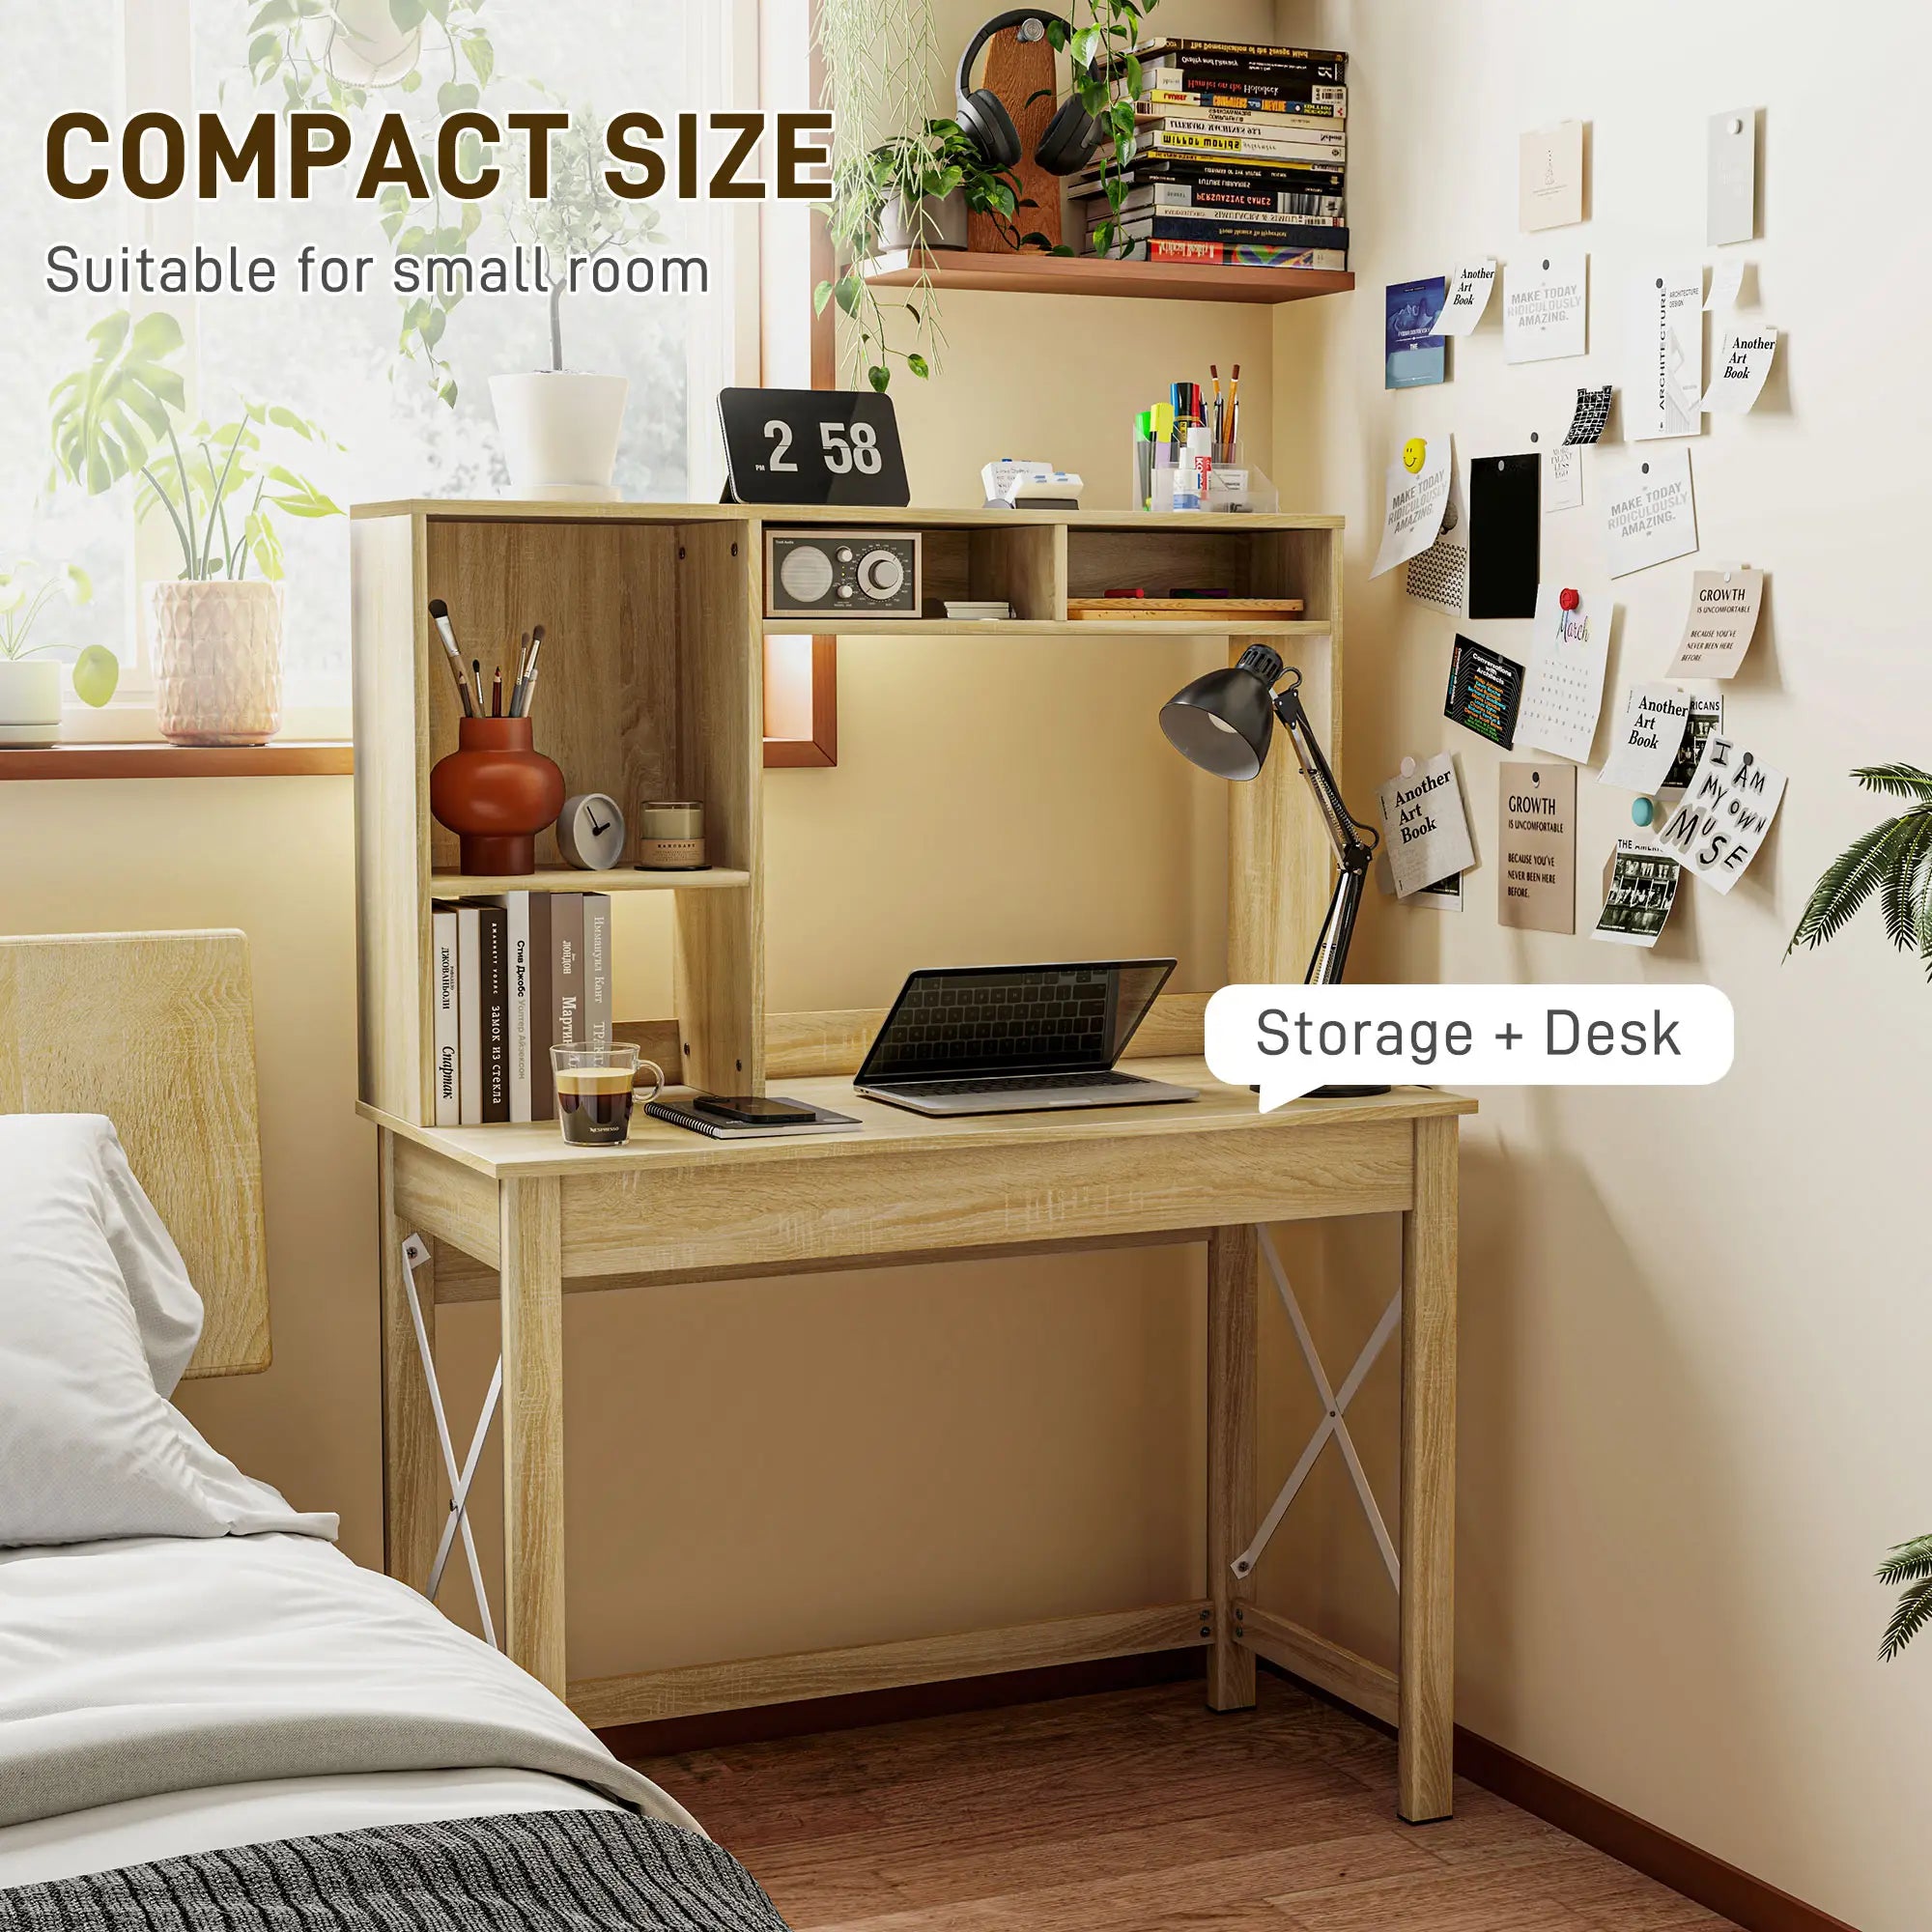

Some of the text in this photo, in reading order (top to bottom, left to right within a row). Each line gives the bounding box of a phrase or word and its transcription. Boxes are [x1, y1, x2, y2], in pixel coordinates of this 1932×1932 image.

[1461, 268, 1494, 279] Another
[1458, 282, 1472, 292] Art
[1511, 284, 1577, 304] MAKE TODAY
[1453, 294, 1474, 305] Book
[1507, 296, 1581, 317] RIDICULOUSLY
[1519, 310, 1569, 327] AMAZING.
[1733, 337, 1776, 349] Another
[1729, 352, 1747, 364] Art
[1724, 366, 1750, 379] Book
[764, 420, 798, 472] 2
[820, 422, 882, 474] 58
[1392, 469, 1445, 510] MAKE TODAY
[1611, 481, 1681, 516] MAKE TODAY
[1607, 491, 1687, 530] RIDICULOUSLY
[1622, 510, 1676, 537] AMAZING.
[1700, 588, 1746, 601] GROWTH
[1703, 605, 1751, 614] UNCOMFORTABLE
[1556, 611, 1589, 643] March
[1638, 695, 1688, 717] Another
[1690, 701, 1719, 710] RICANS
[1634, 713, 1656, 730] Art
[1628, 729, 1659, 749] Book
[1711, 740, 1731, 766] I
[1395, 771, 1450, 808] Another
[1508, 796, 1556, 815] GROWTH
[1700, 775, 1766, 833] MY OWN
[1399, 804, 1422, 826] Art
[1400, 816, 1437, 844] Book
[1508, 820, 1563, 833] IS UNCOMFORTABLE
[1618, 839, 1632, 850] THE
[1508, 853, 1554, 867] BECAUSE YOU'VE
[1507, 870, 1556, 884] NEVER BEEN HERE
[516, 965, 526, 997] Джобс
[439, 1046, 455, 1099] Спартак
